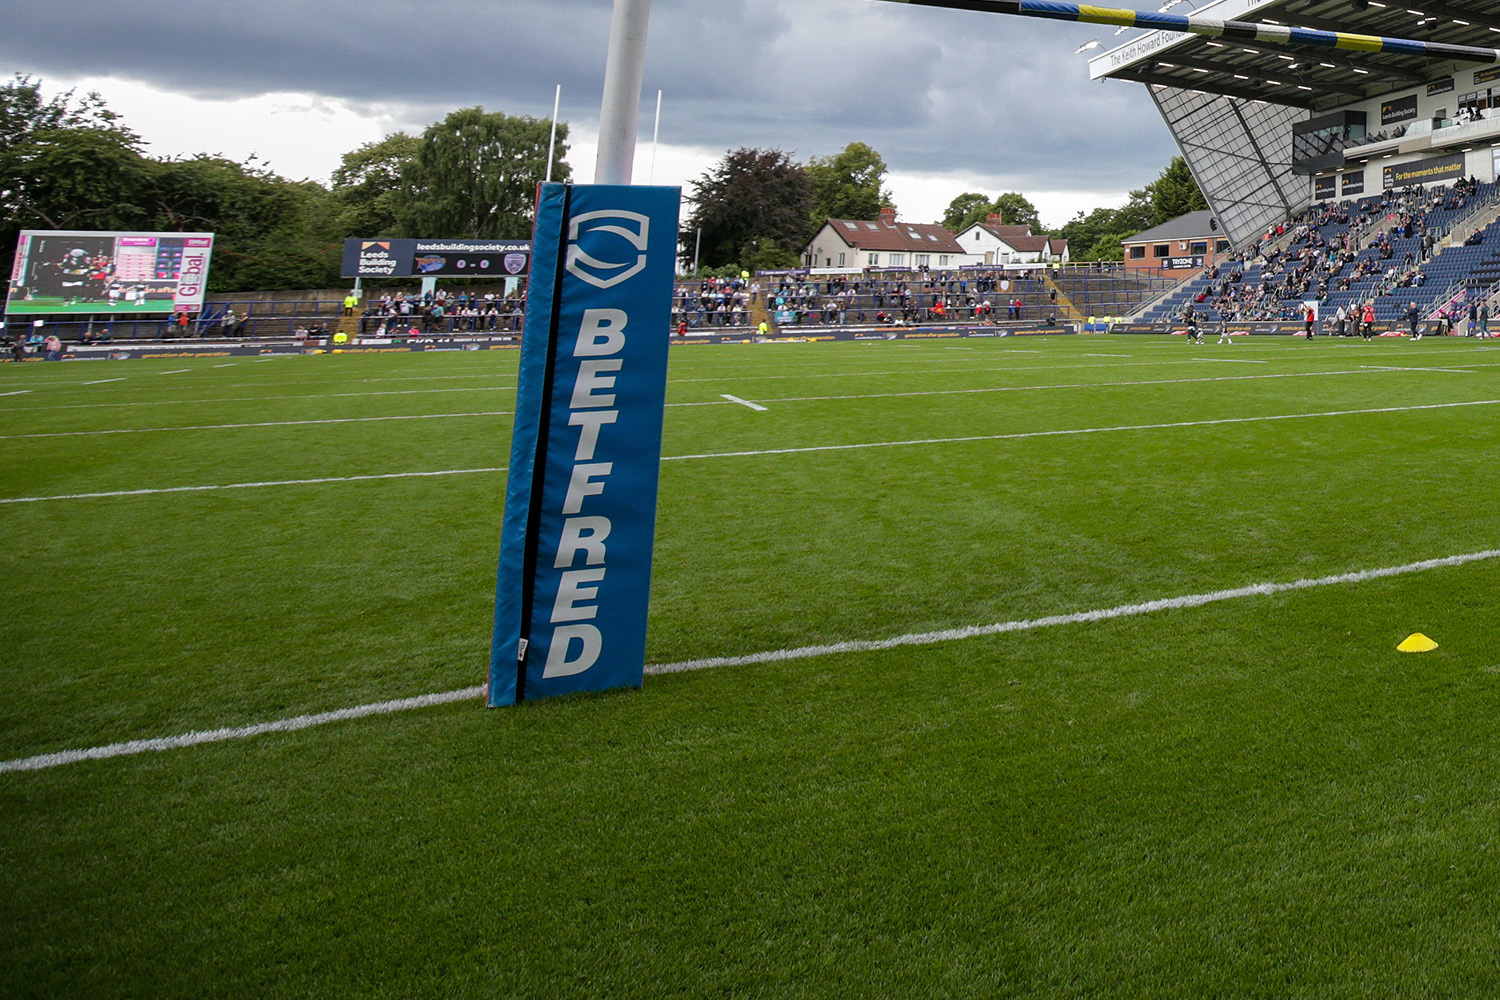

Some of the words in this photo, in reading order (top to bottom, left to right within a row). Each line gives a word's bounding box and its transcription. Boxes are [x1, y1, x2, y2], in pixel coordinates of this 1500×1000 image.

[417, 243, 530, 252] leedsbuildingsociety.co.uk
[360, 251, 389, 259] Leeds
[359, 258, 397, 268] Building
[358, 266, 394, 275] Society
[541, 307, 628, 680] BETFRED
